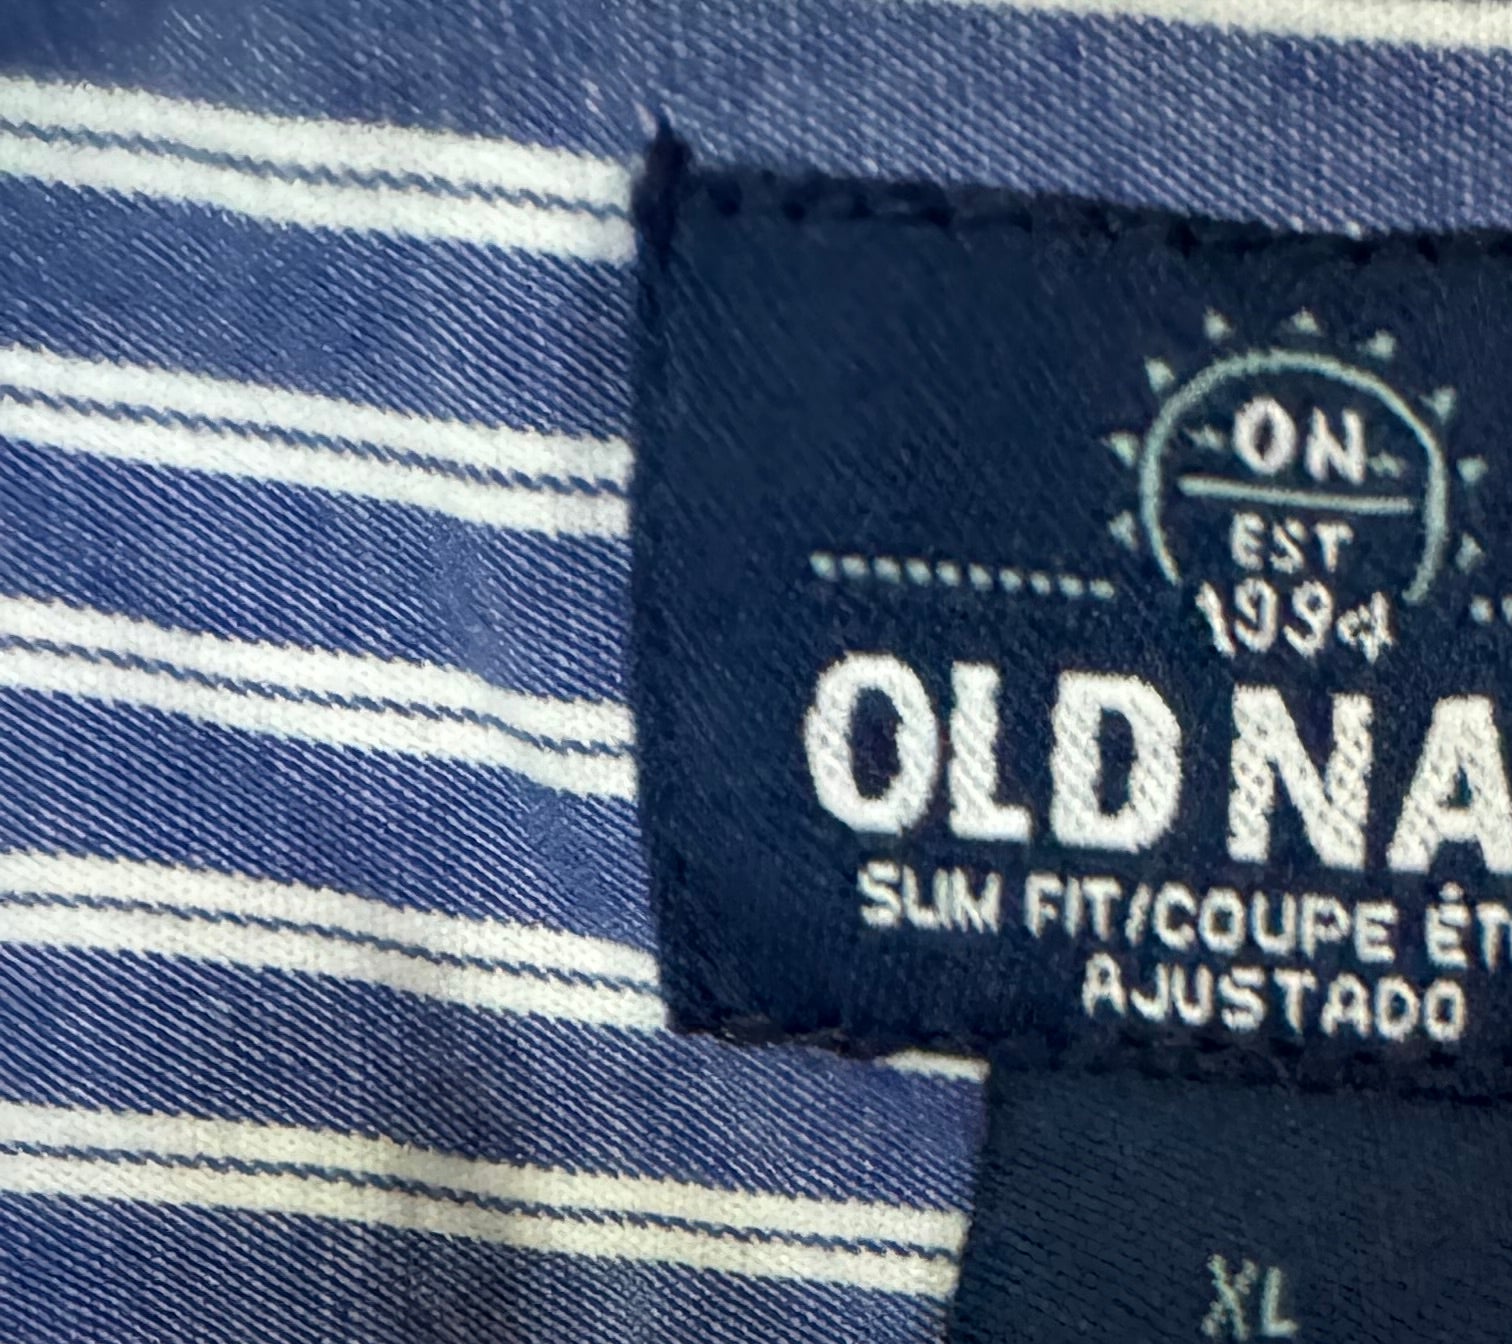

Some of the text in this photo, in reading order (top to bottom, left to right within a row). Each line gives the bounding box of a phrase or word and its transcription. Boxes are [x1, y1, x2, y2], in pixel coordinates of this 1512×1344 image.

[1232, 398, 1365, 482] ON
[1230, 511, 1354, 573] EST
[1196, 579, 1394, 662] 1994
[805, 651, 1183, 851] OLD
[856, 861, 1001, 933] SLIM
[1023, 873, 1397, 965] FIT/COUPE
[1081, 953, 1467, 1042] AJUSTADO
[1201, 1254, 1297, 1341] XL
